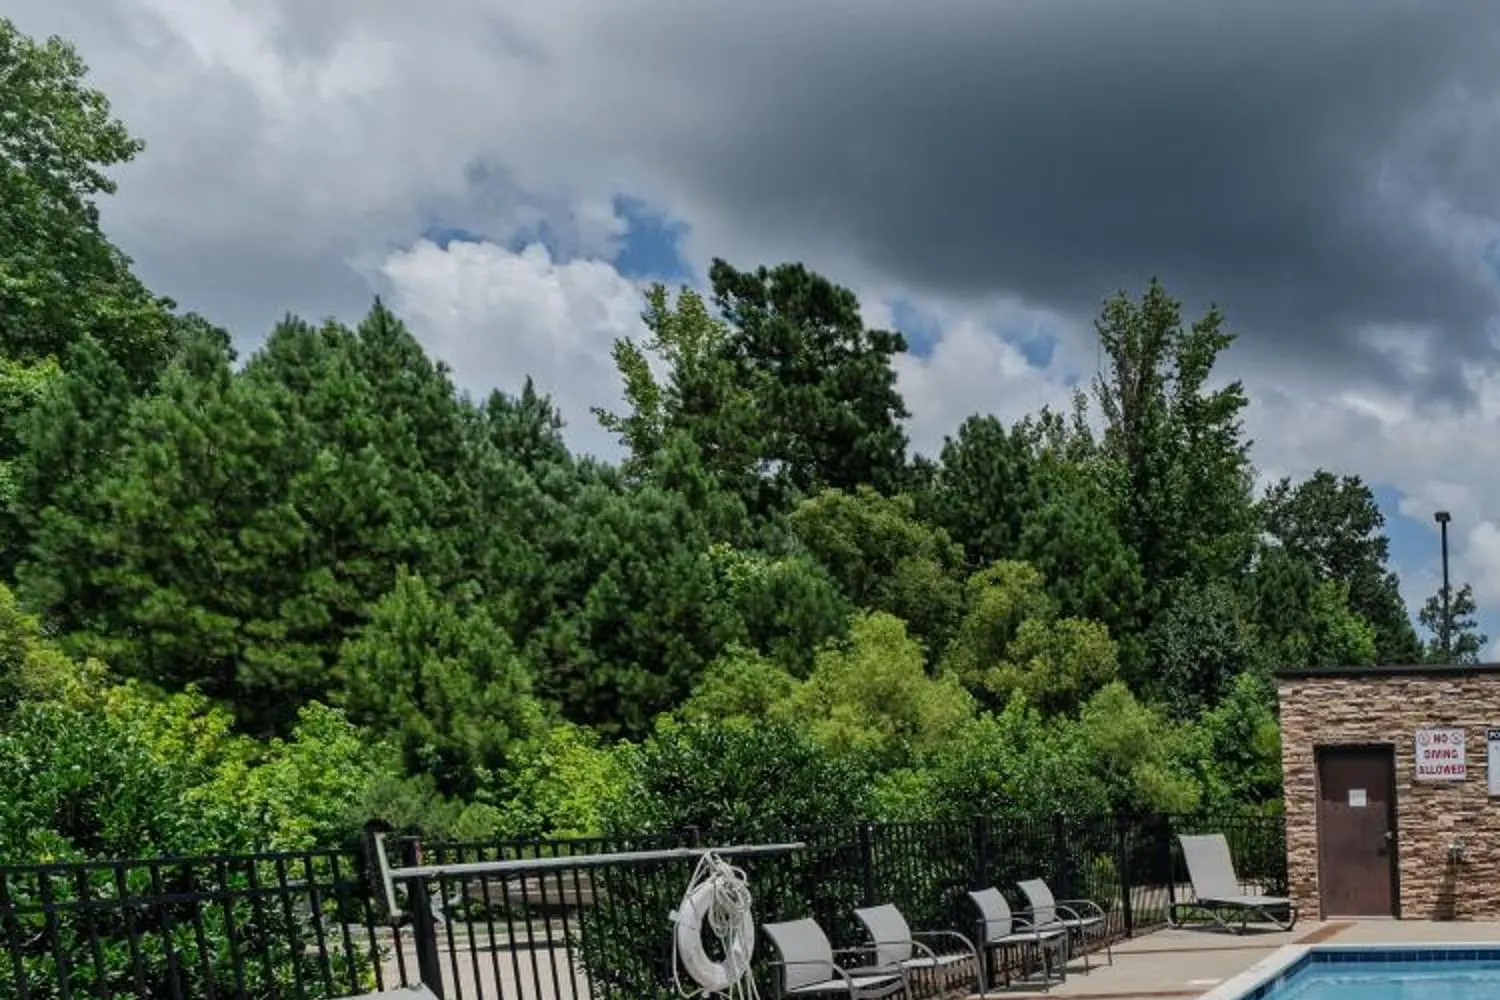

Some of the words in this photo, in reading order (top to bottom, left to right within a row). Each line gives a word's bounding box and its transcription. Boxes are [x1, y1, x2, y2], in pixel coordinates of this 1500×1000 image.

[1433, 733, 1449, 744] NO
[1424, 749, 1459, 759] DIVING
[1418, 765, 1465, 775] ALLOWED
